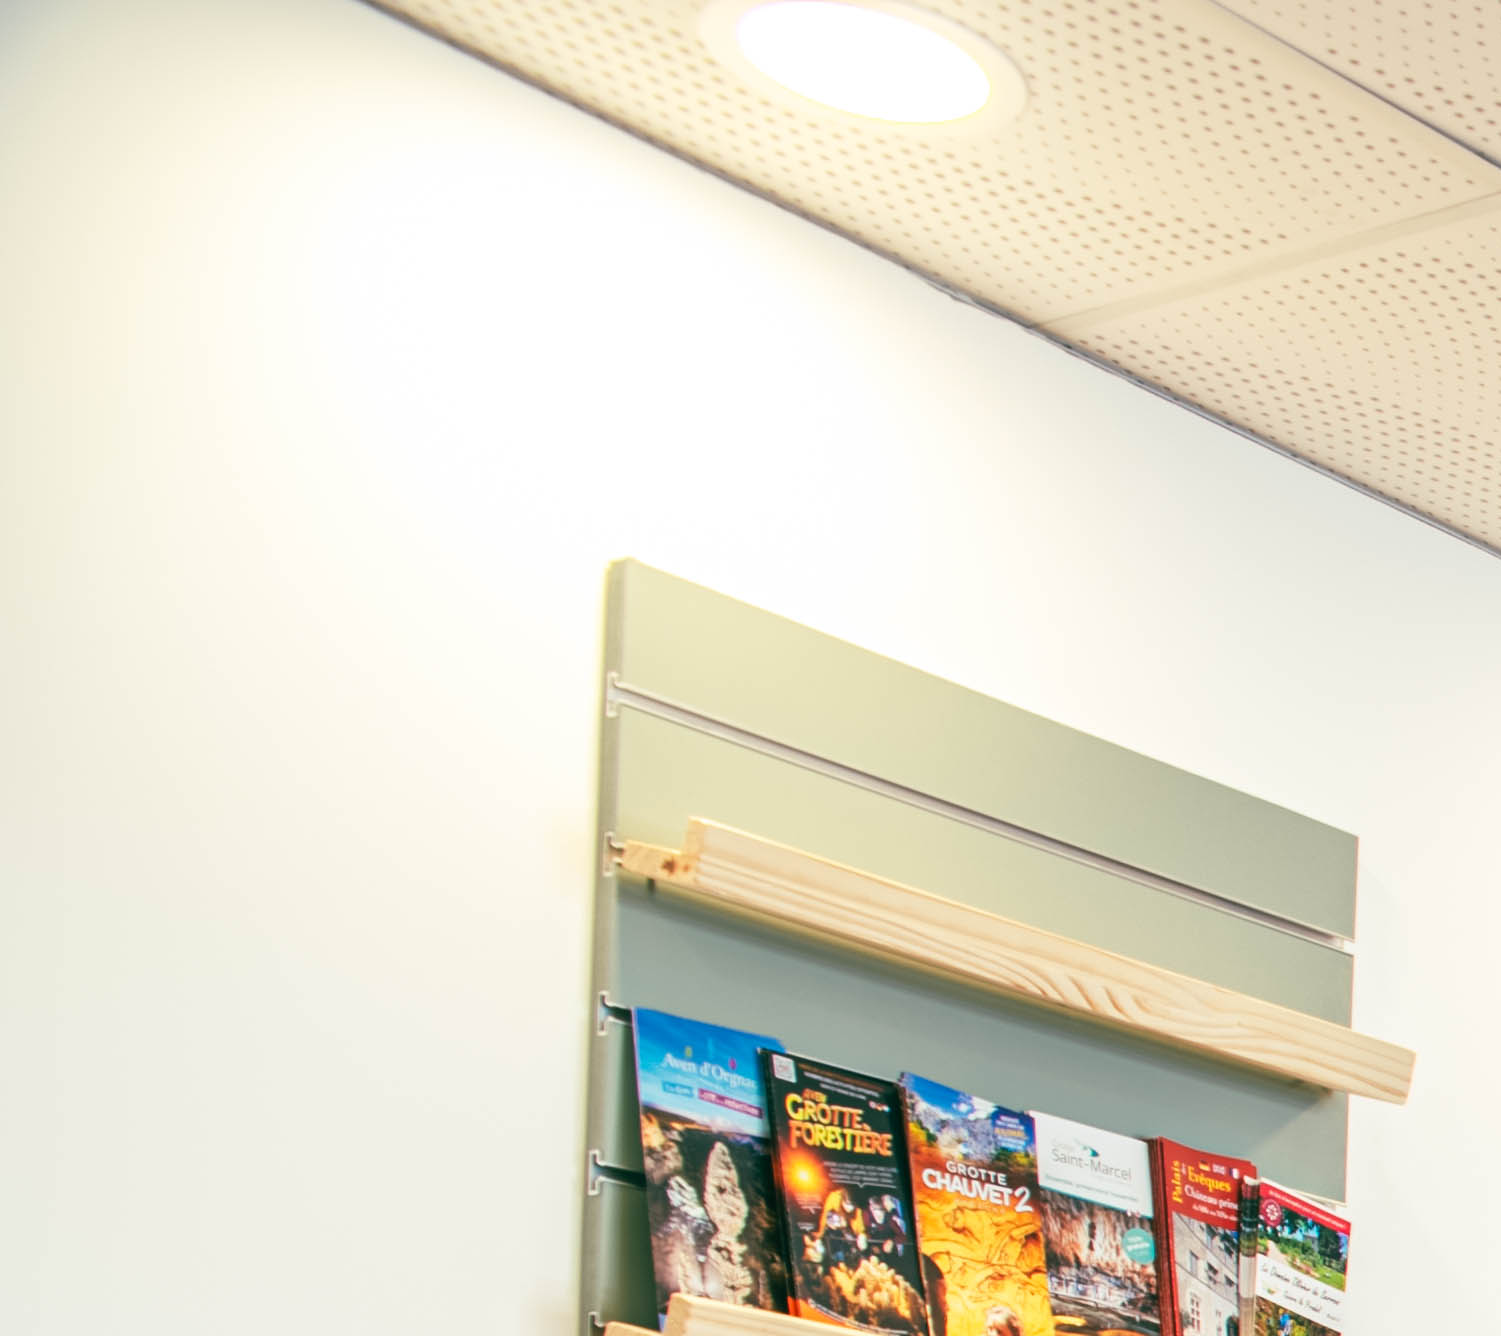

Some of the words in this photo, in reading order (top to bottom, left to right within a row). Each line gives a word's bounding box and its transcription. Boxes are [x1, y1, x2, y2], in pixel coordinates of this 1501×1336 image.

[661, 1053, 698, 1074] Aven
[785, 1092, 866, 1130] GROTTE
[945, 1160, 1008, 1187] GROTTE
[1051, 1148, 1133, 1181] Saint-Marcel
[922, 1168, 1012, 1207] CHAUVET
[1013, 1185, 1034, 1214] 2
[1171, 1160, 1184, 1205] Palais
